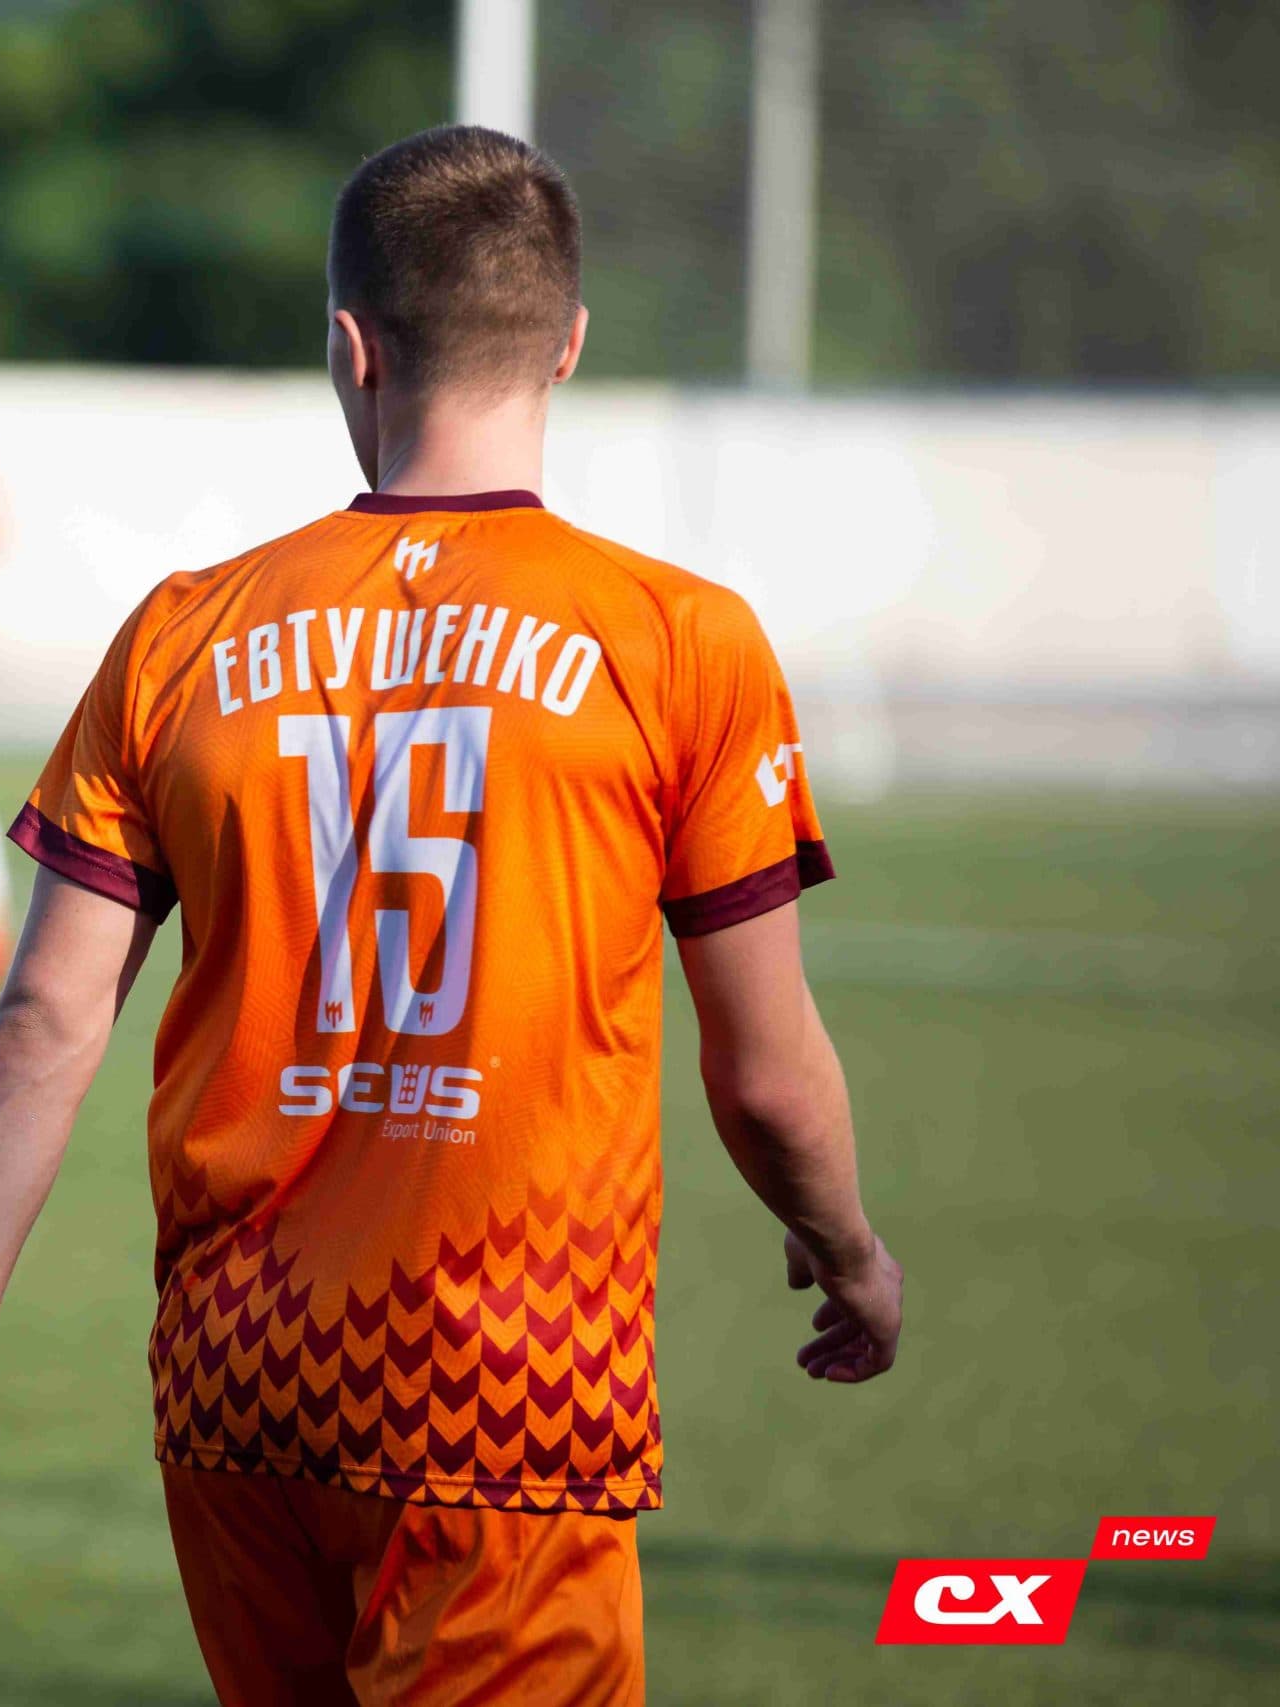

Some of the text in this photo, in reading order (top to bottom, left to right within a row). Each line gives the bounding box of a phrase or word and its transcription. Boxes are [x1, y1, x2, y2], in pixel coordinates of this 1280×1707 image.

[213, 603, 602, 717] ЕВТУШЕНКО
[278, 706, 493, 1036] 15
[278, 1062, 483, 1119] SEUS
[381, 1119, 476, 1145] Export Union
